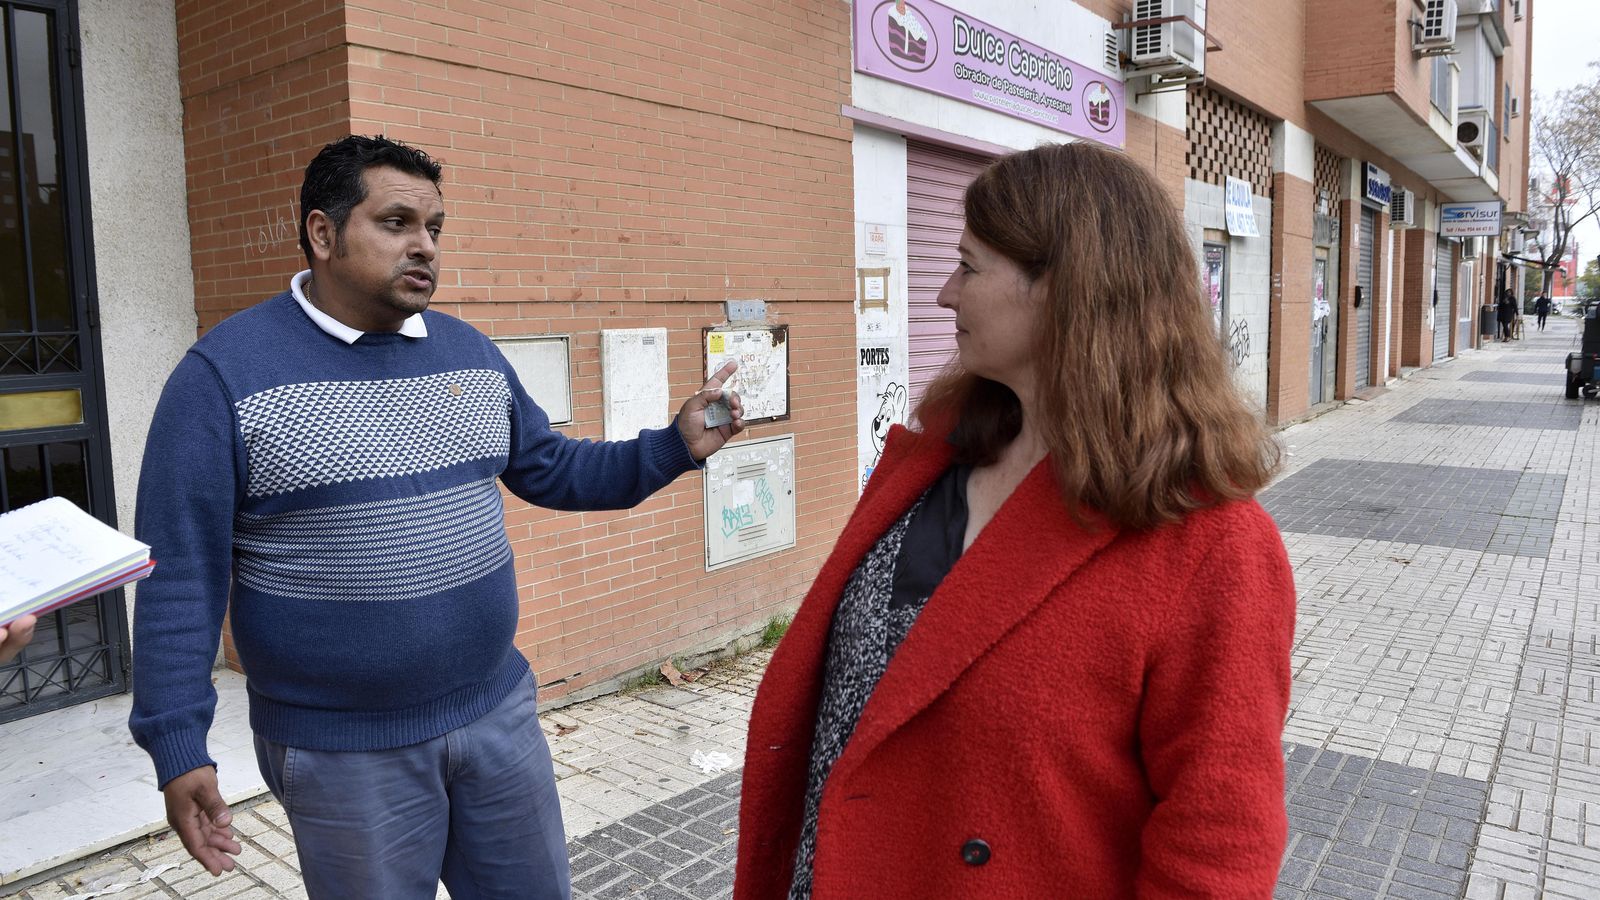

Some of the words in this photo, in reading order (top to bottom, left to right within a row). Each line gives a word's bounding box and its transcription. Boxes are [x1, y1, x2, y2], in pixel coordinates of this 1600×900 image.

[953, 15, 1005, 66] Dulce
[1008, 40, 1073, 91] Capricho
[954, 62, 990, 86] Obrador
[991, 76, 1003, 90] de
[1039, 93, 1072, 116] Artesanal
[1442, 206, 1498, 219] Servisur
[860, 347, 890, 366] PORTES
